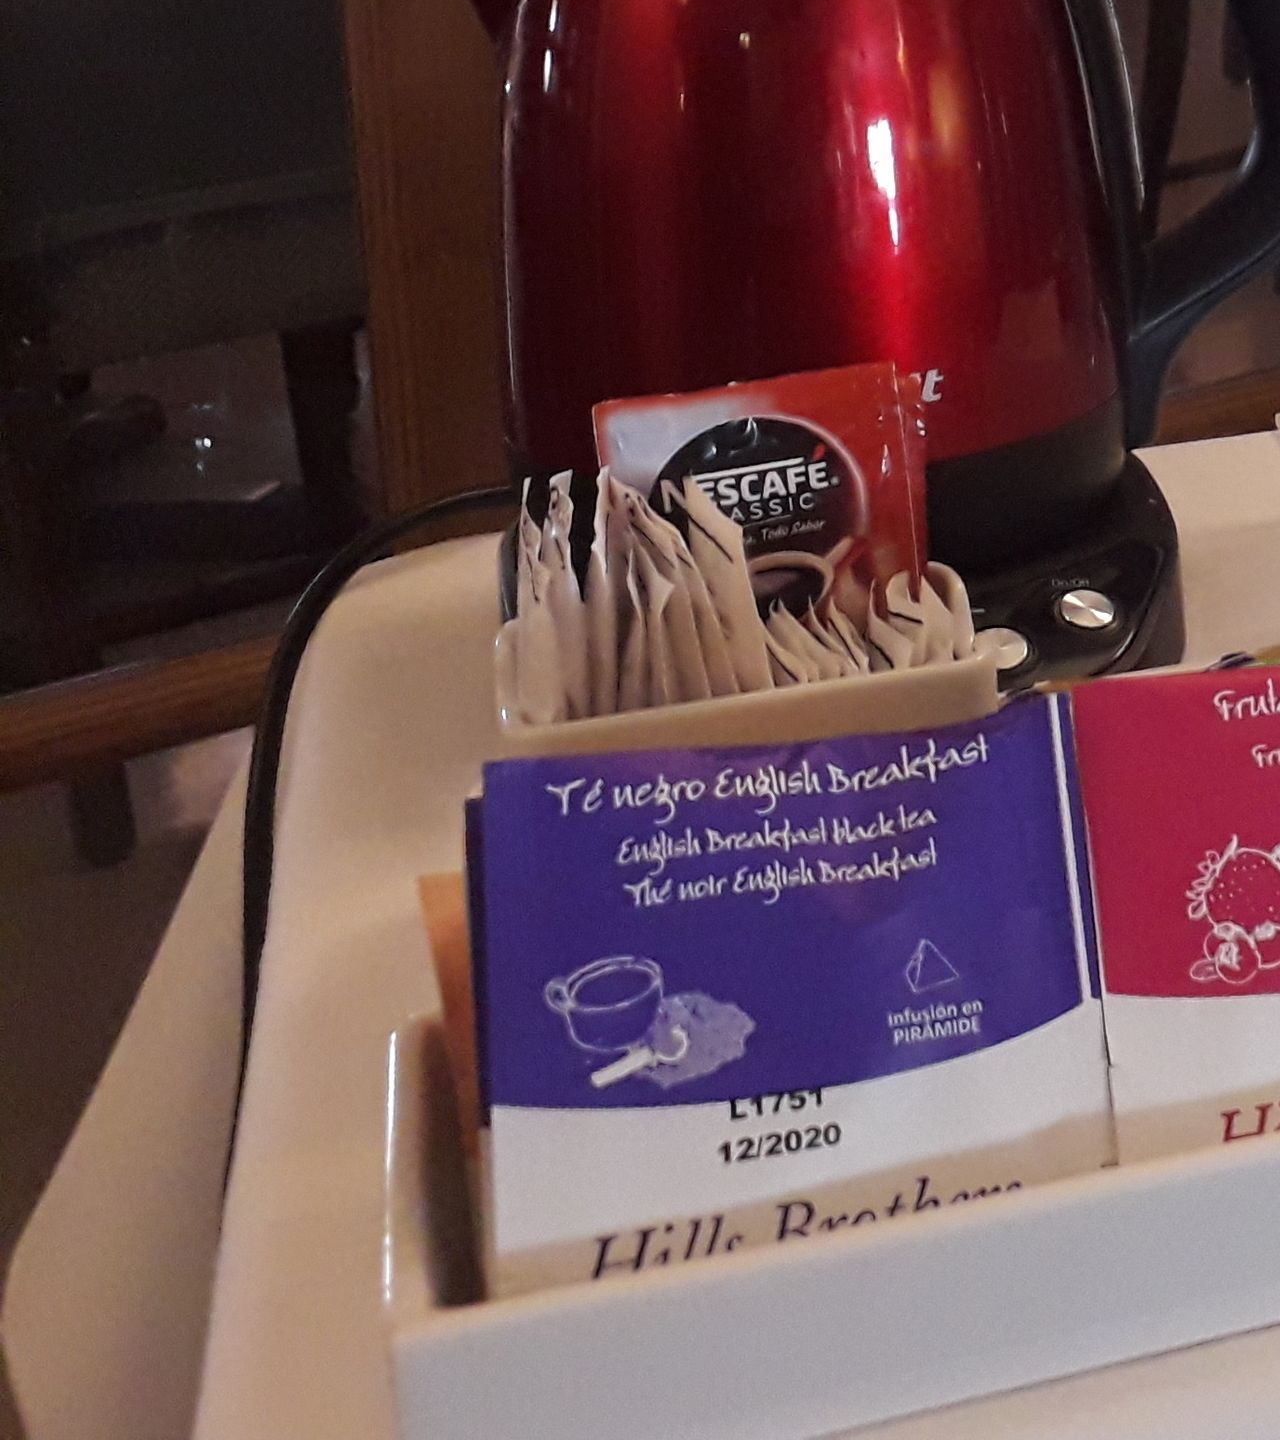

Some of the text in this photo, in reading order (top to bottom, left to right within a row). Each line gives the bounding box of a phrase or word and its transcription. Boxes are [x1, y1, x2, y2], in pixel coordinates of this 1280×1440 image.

[730, 492, 816, 522] ASSIC
[546, 733, 991, 824] Té negro English Breakfast
[617, 803, 938, 876] English Breakfast black tea
[622, 836, 938, 907] Thé noir English Breakfast
[961, 999, 983, 1016] en
[730, 1086, 822, 1120] L1751
[719, 1122, 842, 1164] 12/2020
